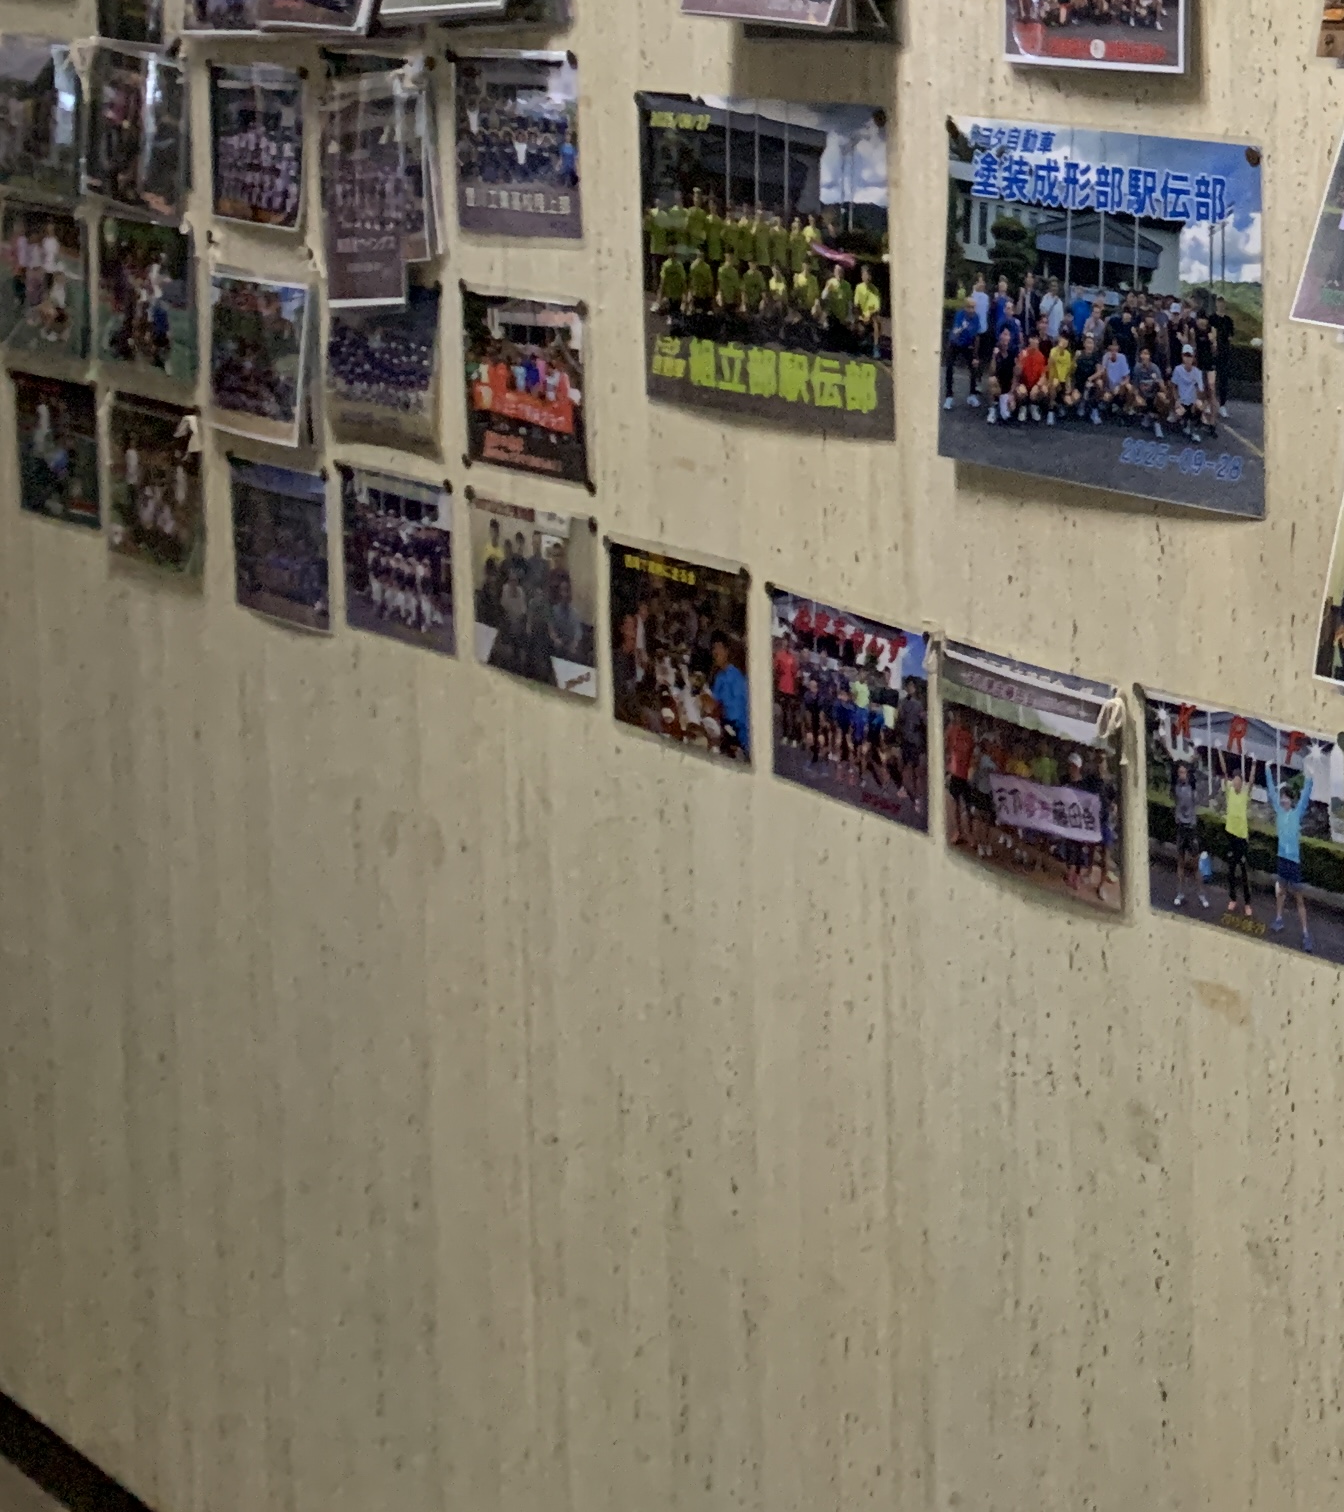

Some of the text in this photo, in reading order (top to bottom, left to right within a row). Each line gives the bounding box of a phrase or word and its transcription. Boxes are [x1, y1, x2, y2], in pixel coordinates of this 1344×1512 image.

[971, 151, 1226, 224] 塗装成形部駅伝部
